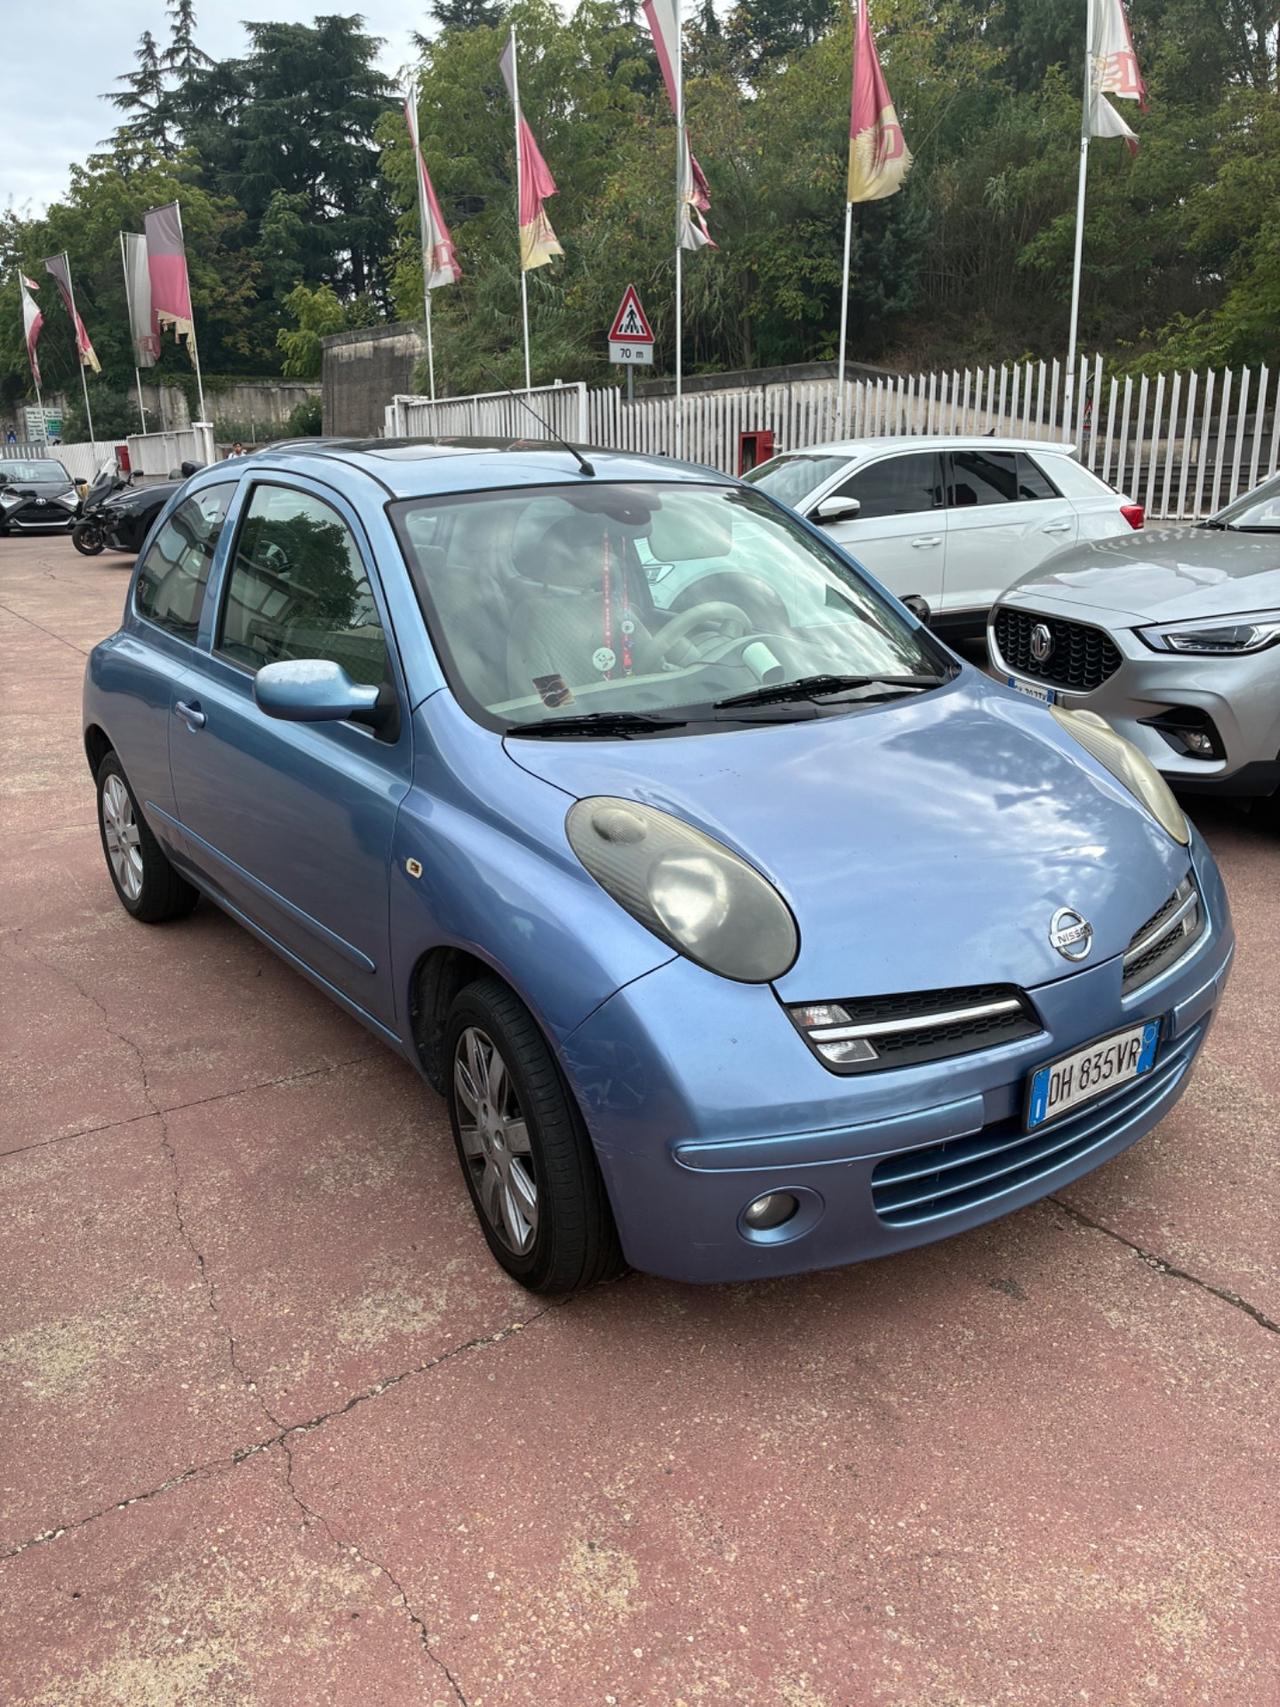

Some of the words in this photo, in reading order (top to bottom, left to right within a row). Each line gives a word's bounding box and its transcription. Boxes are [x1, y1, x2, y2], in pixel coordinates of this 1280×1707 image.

[620, 348, 631, 358] 70
[1048, 1064, 1074, 1107] DH
[1079, 1037, 1141, 1090] 835VR
